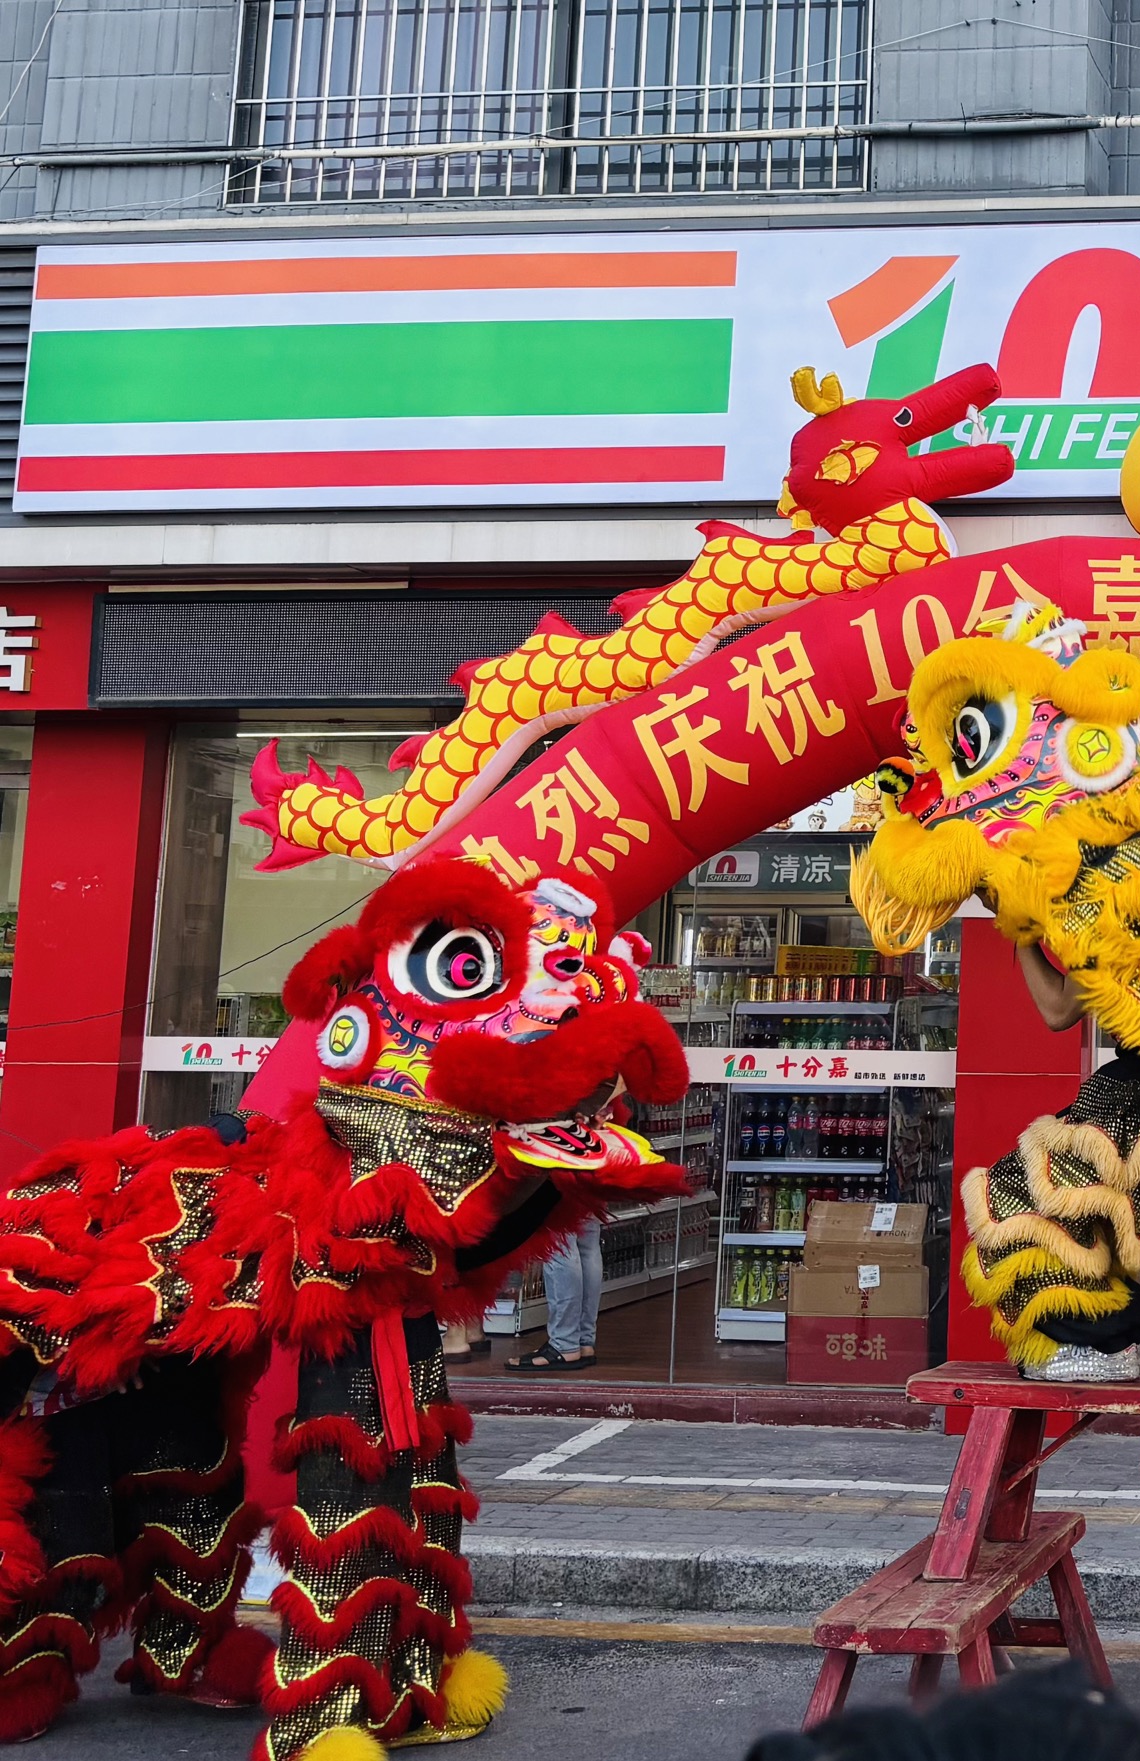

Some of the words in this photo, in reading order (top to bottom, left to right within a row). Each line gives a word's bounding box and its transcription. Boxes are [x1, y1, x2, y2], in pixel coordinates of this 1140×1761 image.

[723, 1054, 756, 1078] 10
[776, 1055, 850, 1079] 十分嘉
[825, 1332, 888, 1362] 百草味
